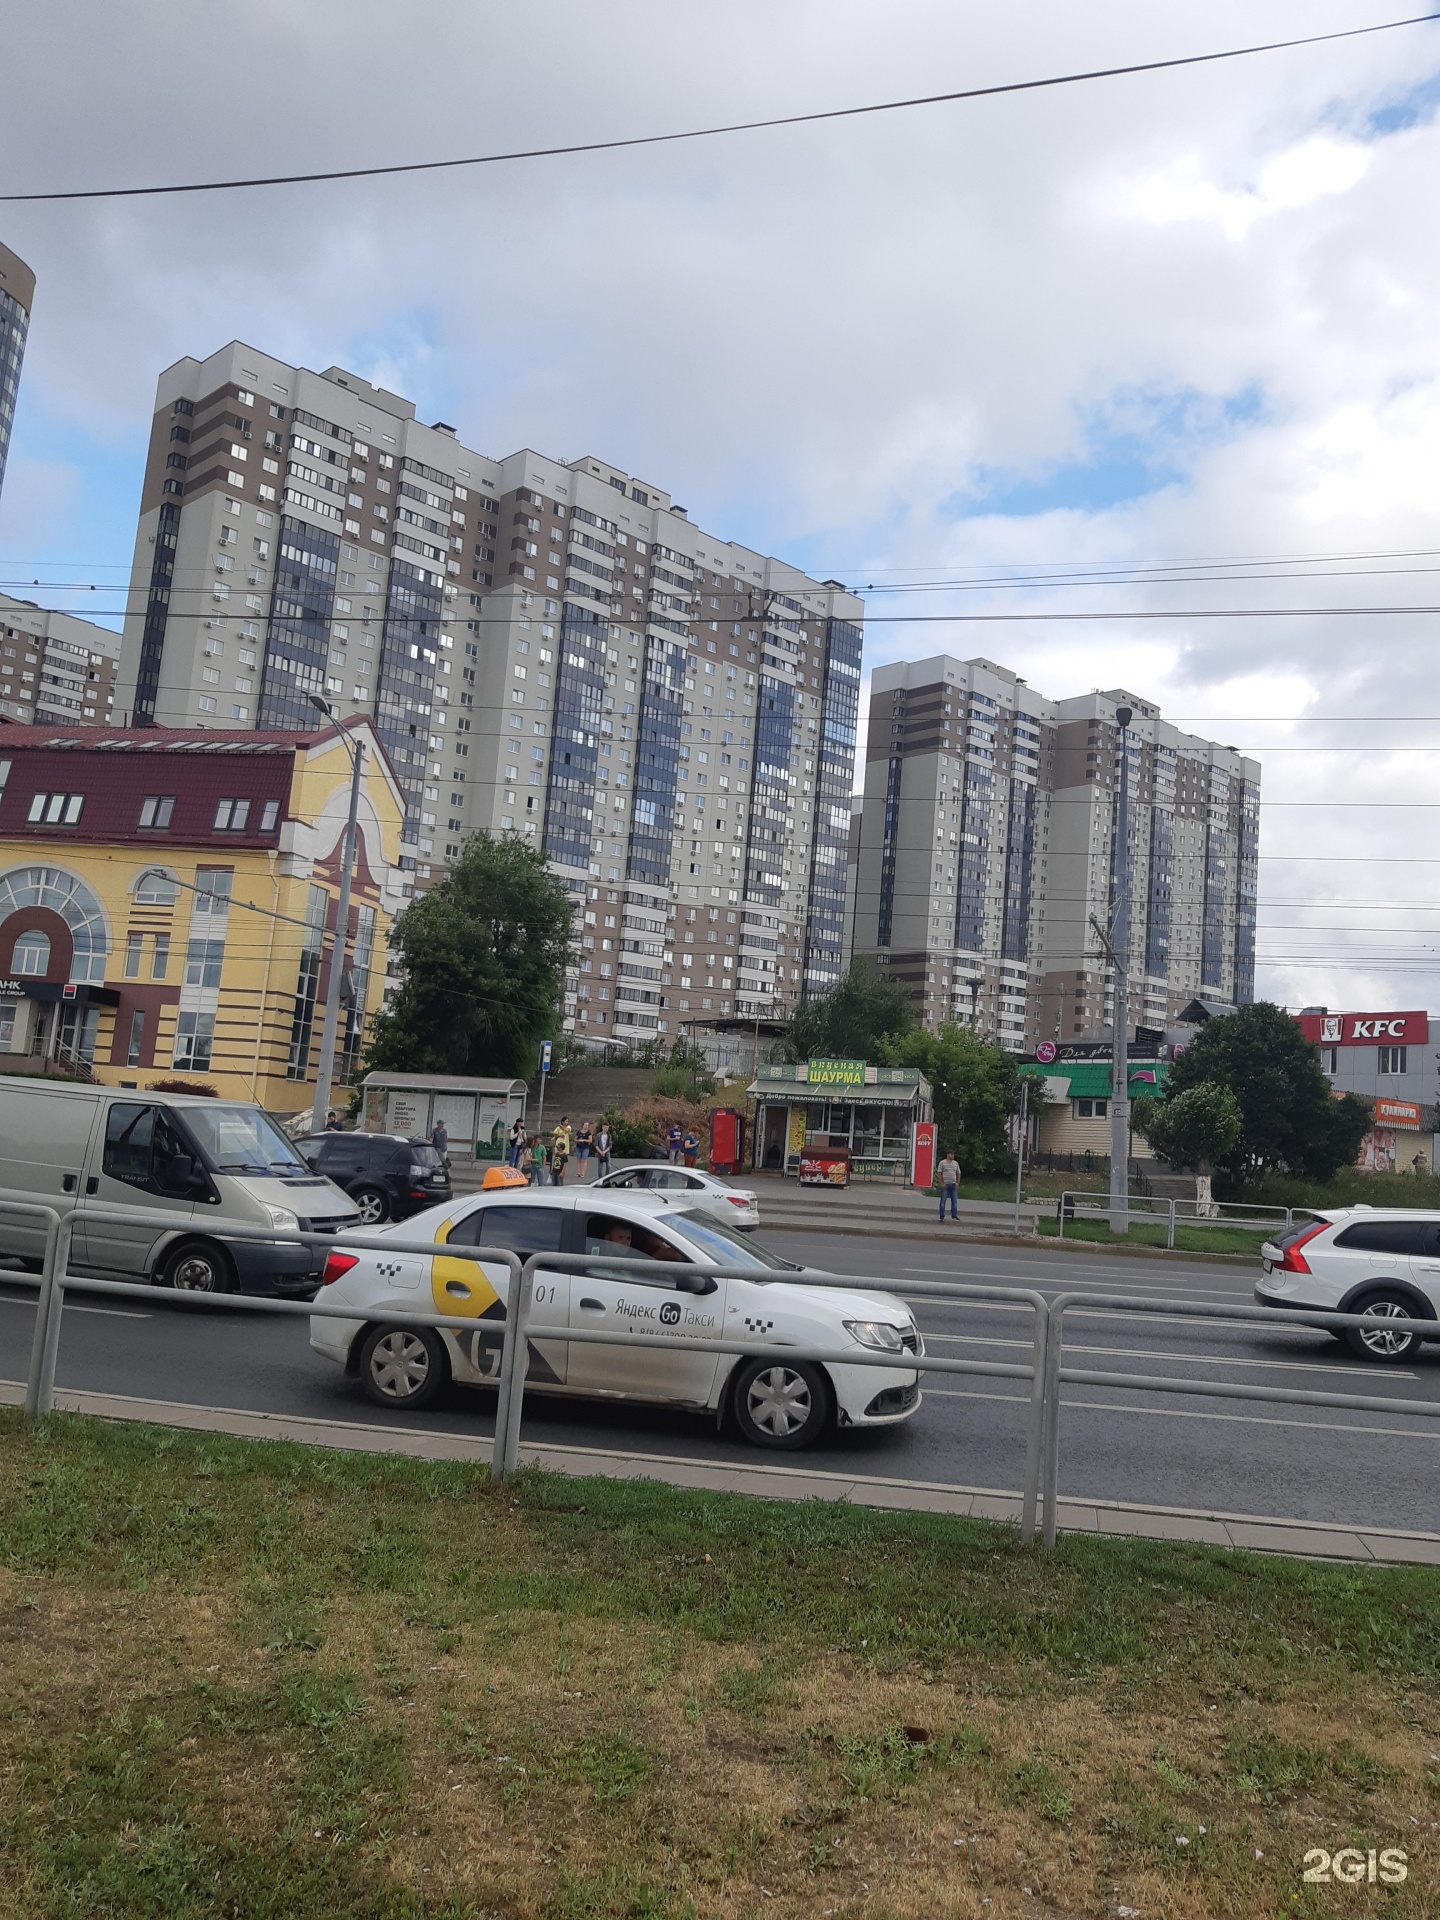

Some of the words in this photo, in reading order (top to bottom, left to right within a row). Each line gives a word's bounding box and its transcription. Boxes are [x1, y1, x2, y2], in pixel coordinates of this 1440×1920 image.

[1352, 1019, 1406, 1038] KFC
[1089, 1045, 1113, 1058] двои
[810, 1071, 861, 1084] ШАУРМА
[536, 1285, 555, 1304] 01
[615, 1299, 657, 1319] Яндекс
[661, 1305, 679, 1322] Go
[684, 1307, 715, 1327] Такси
